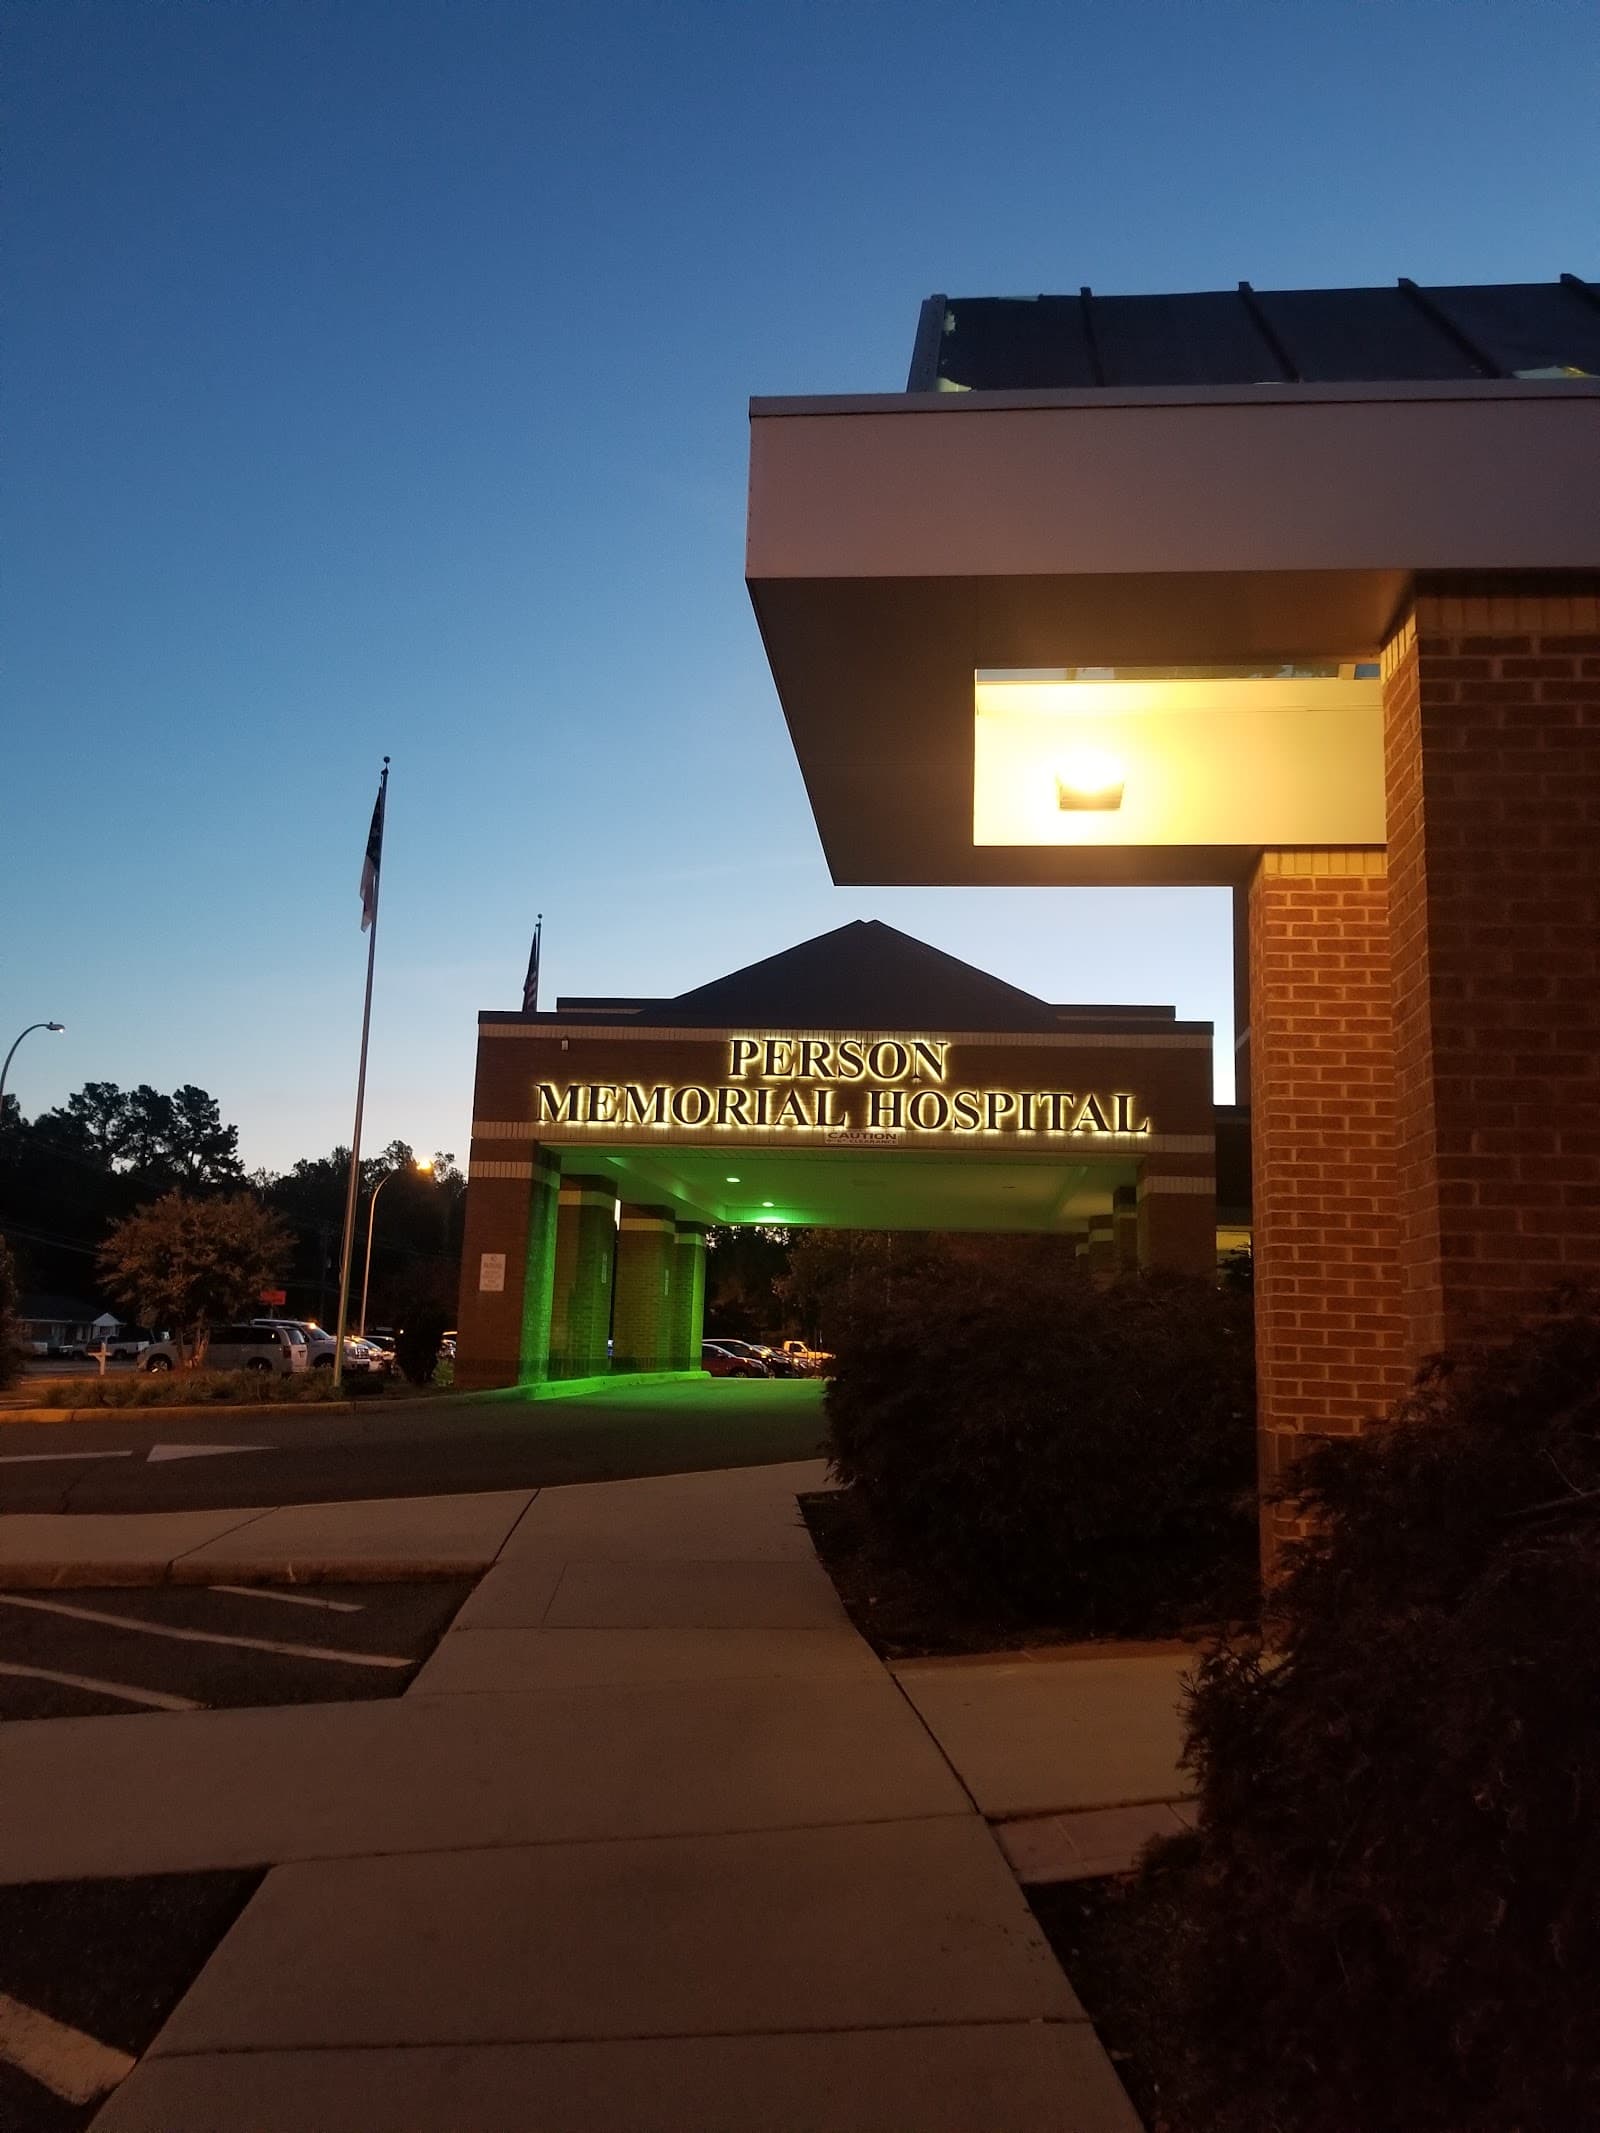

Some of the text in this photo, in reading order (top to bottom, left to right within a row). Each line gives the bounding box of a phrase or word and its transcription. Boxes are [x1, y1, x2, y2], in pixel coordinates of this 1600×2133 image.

[728, 1038, 948, 1080] PERSON
[536, 1084, 1149, 1132] MEMORIAL HOSPITAL
[828, 1132, 897, 1140] CAUTION
